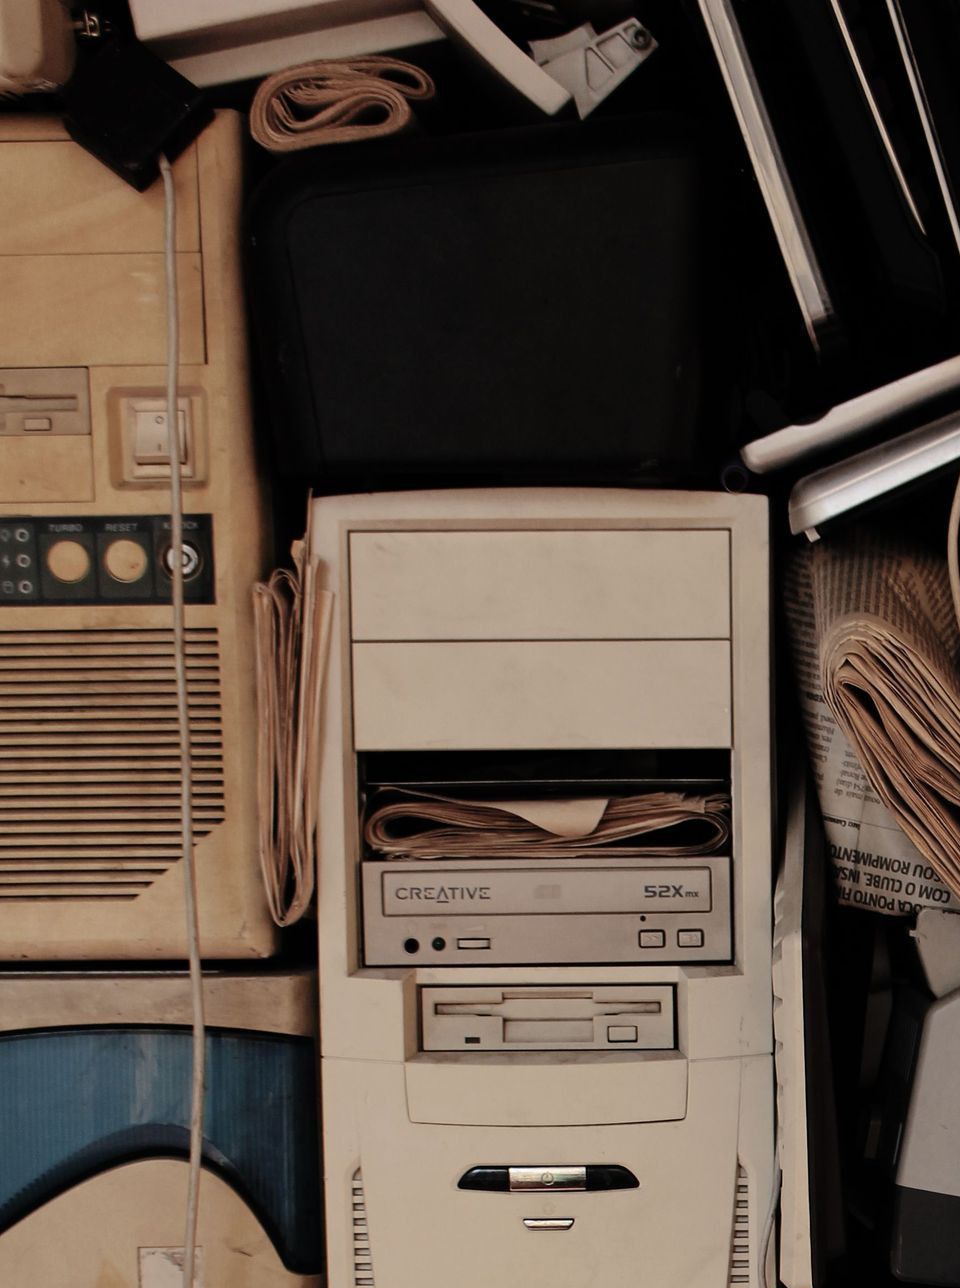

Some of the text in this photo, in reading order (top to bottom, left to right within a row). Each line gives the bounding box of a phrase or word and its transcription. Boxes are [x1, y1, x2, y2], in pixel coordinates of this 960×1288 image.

[48, 523, 83, 532] TURBO
[104, 523, 138, 532] RESET
[863, 872, 902, 893] CLUBE.
[905, 882, 916, 895] O
[394, 886, 491, 903] CREATIVE
[854, 891, 895, 910] PONTO
[918, 885, 950, 904] COM
